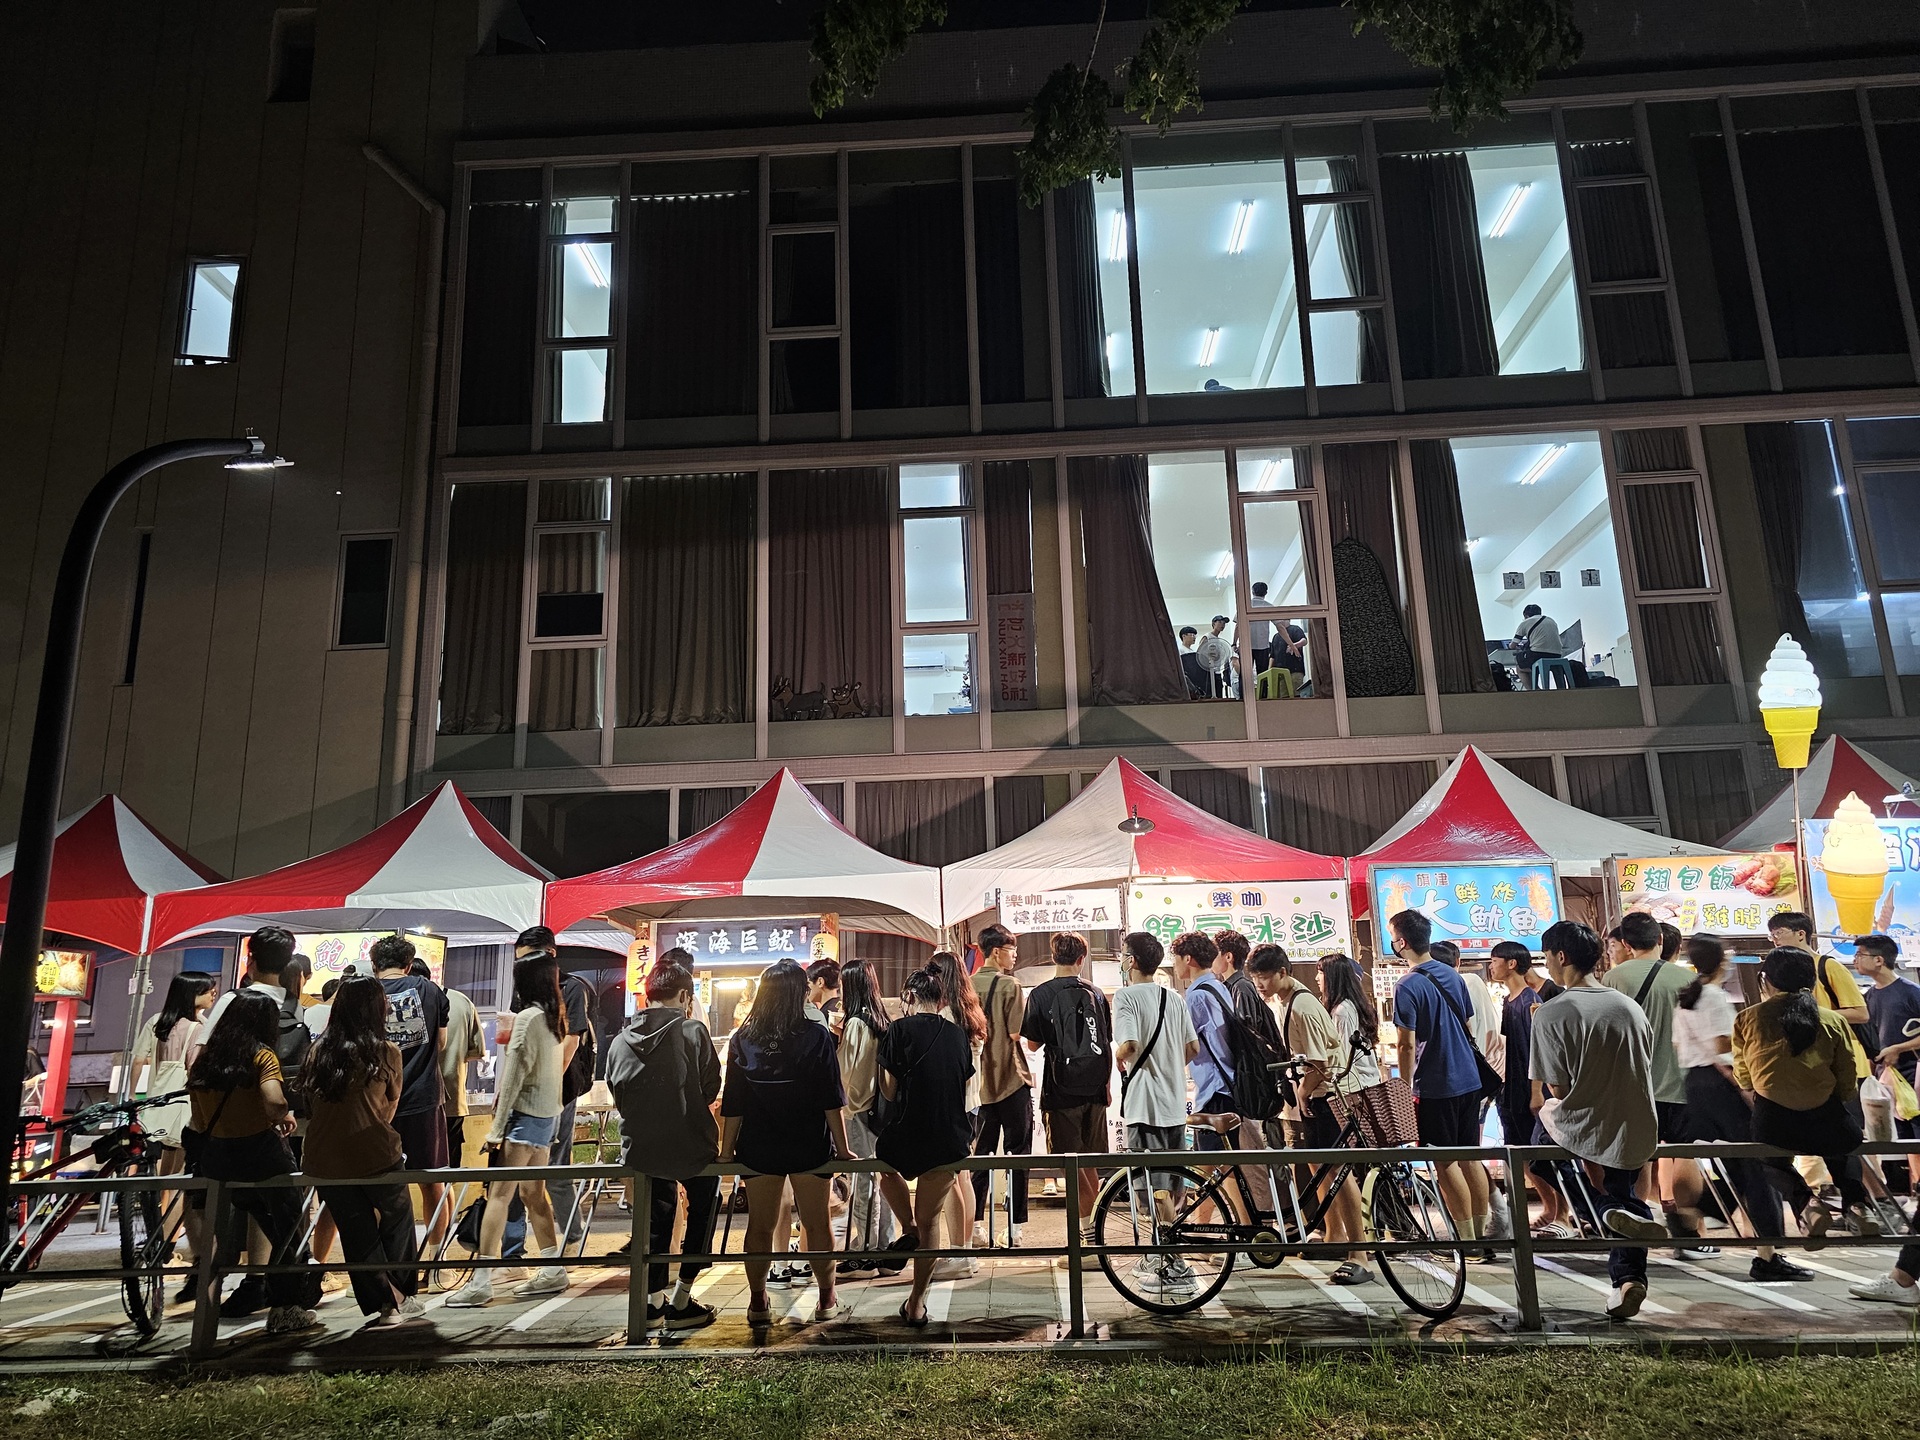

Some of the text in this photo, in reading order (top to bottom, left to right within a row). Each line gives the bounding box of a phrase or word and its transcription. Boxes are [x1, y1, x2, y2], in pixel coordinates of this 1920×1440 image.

[1000, 674, 1009, 701] HAO
[1416, 871, 1450, 888] 旗津
[1643, 863, 1737, 893] 翅包飯
[1005, 893, 1043, 908] 樂咖
[1211, 891, 1263, 908] 樂咖
[1454, 880, 1517, 904] 鮮炸
[1012, 904, 1109, 925] 檸檬尬冬瓜
[1410, 888, 1541, 937] 大魷魚
[675, 927, 795, 955] 深海巨魷
[1085, 1016, 1098, 1043] asics
